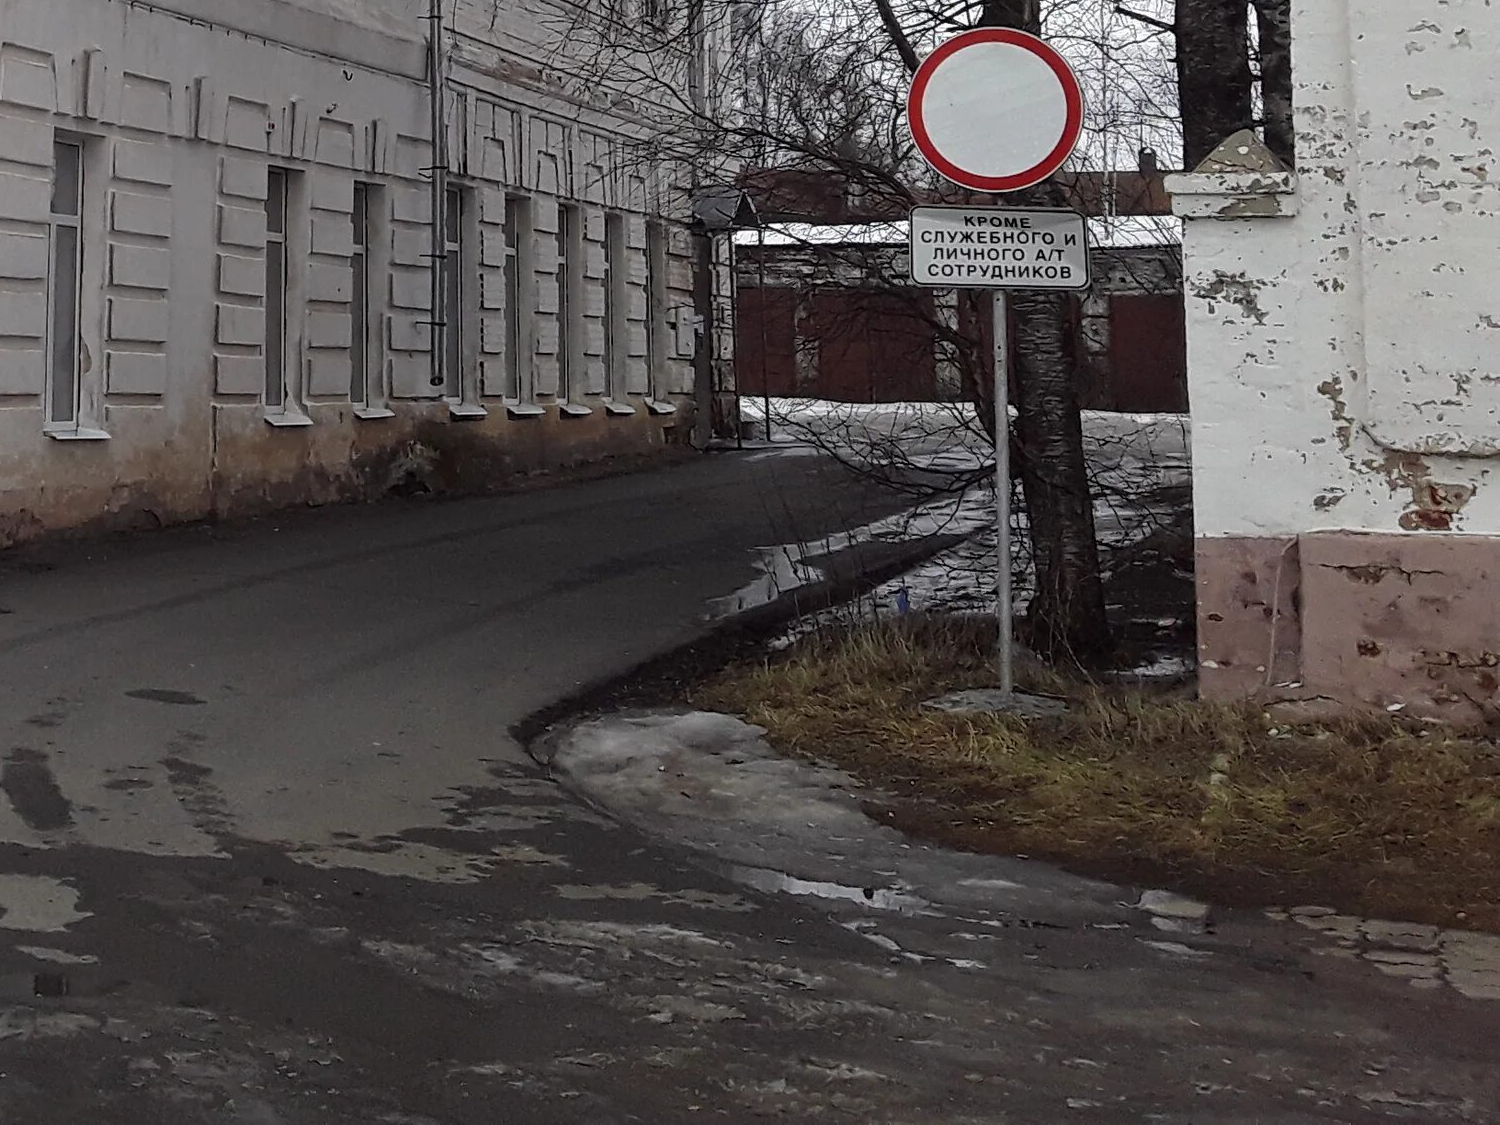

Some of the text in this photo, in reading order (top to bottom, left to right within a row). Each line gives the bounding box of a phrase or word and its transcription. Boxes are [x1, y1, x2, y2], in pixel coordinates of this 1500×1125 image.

[963, 215, 1032, 229] КРОМЕ
[920, 230, 1077, 247] СЛУЖЕБНОГО И
[932, 247, 1065, 262] ЛИЧНОГО А/Т
[927, 263, 1072, 280] СОТРУДНИКОВ
